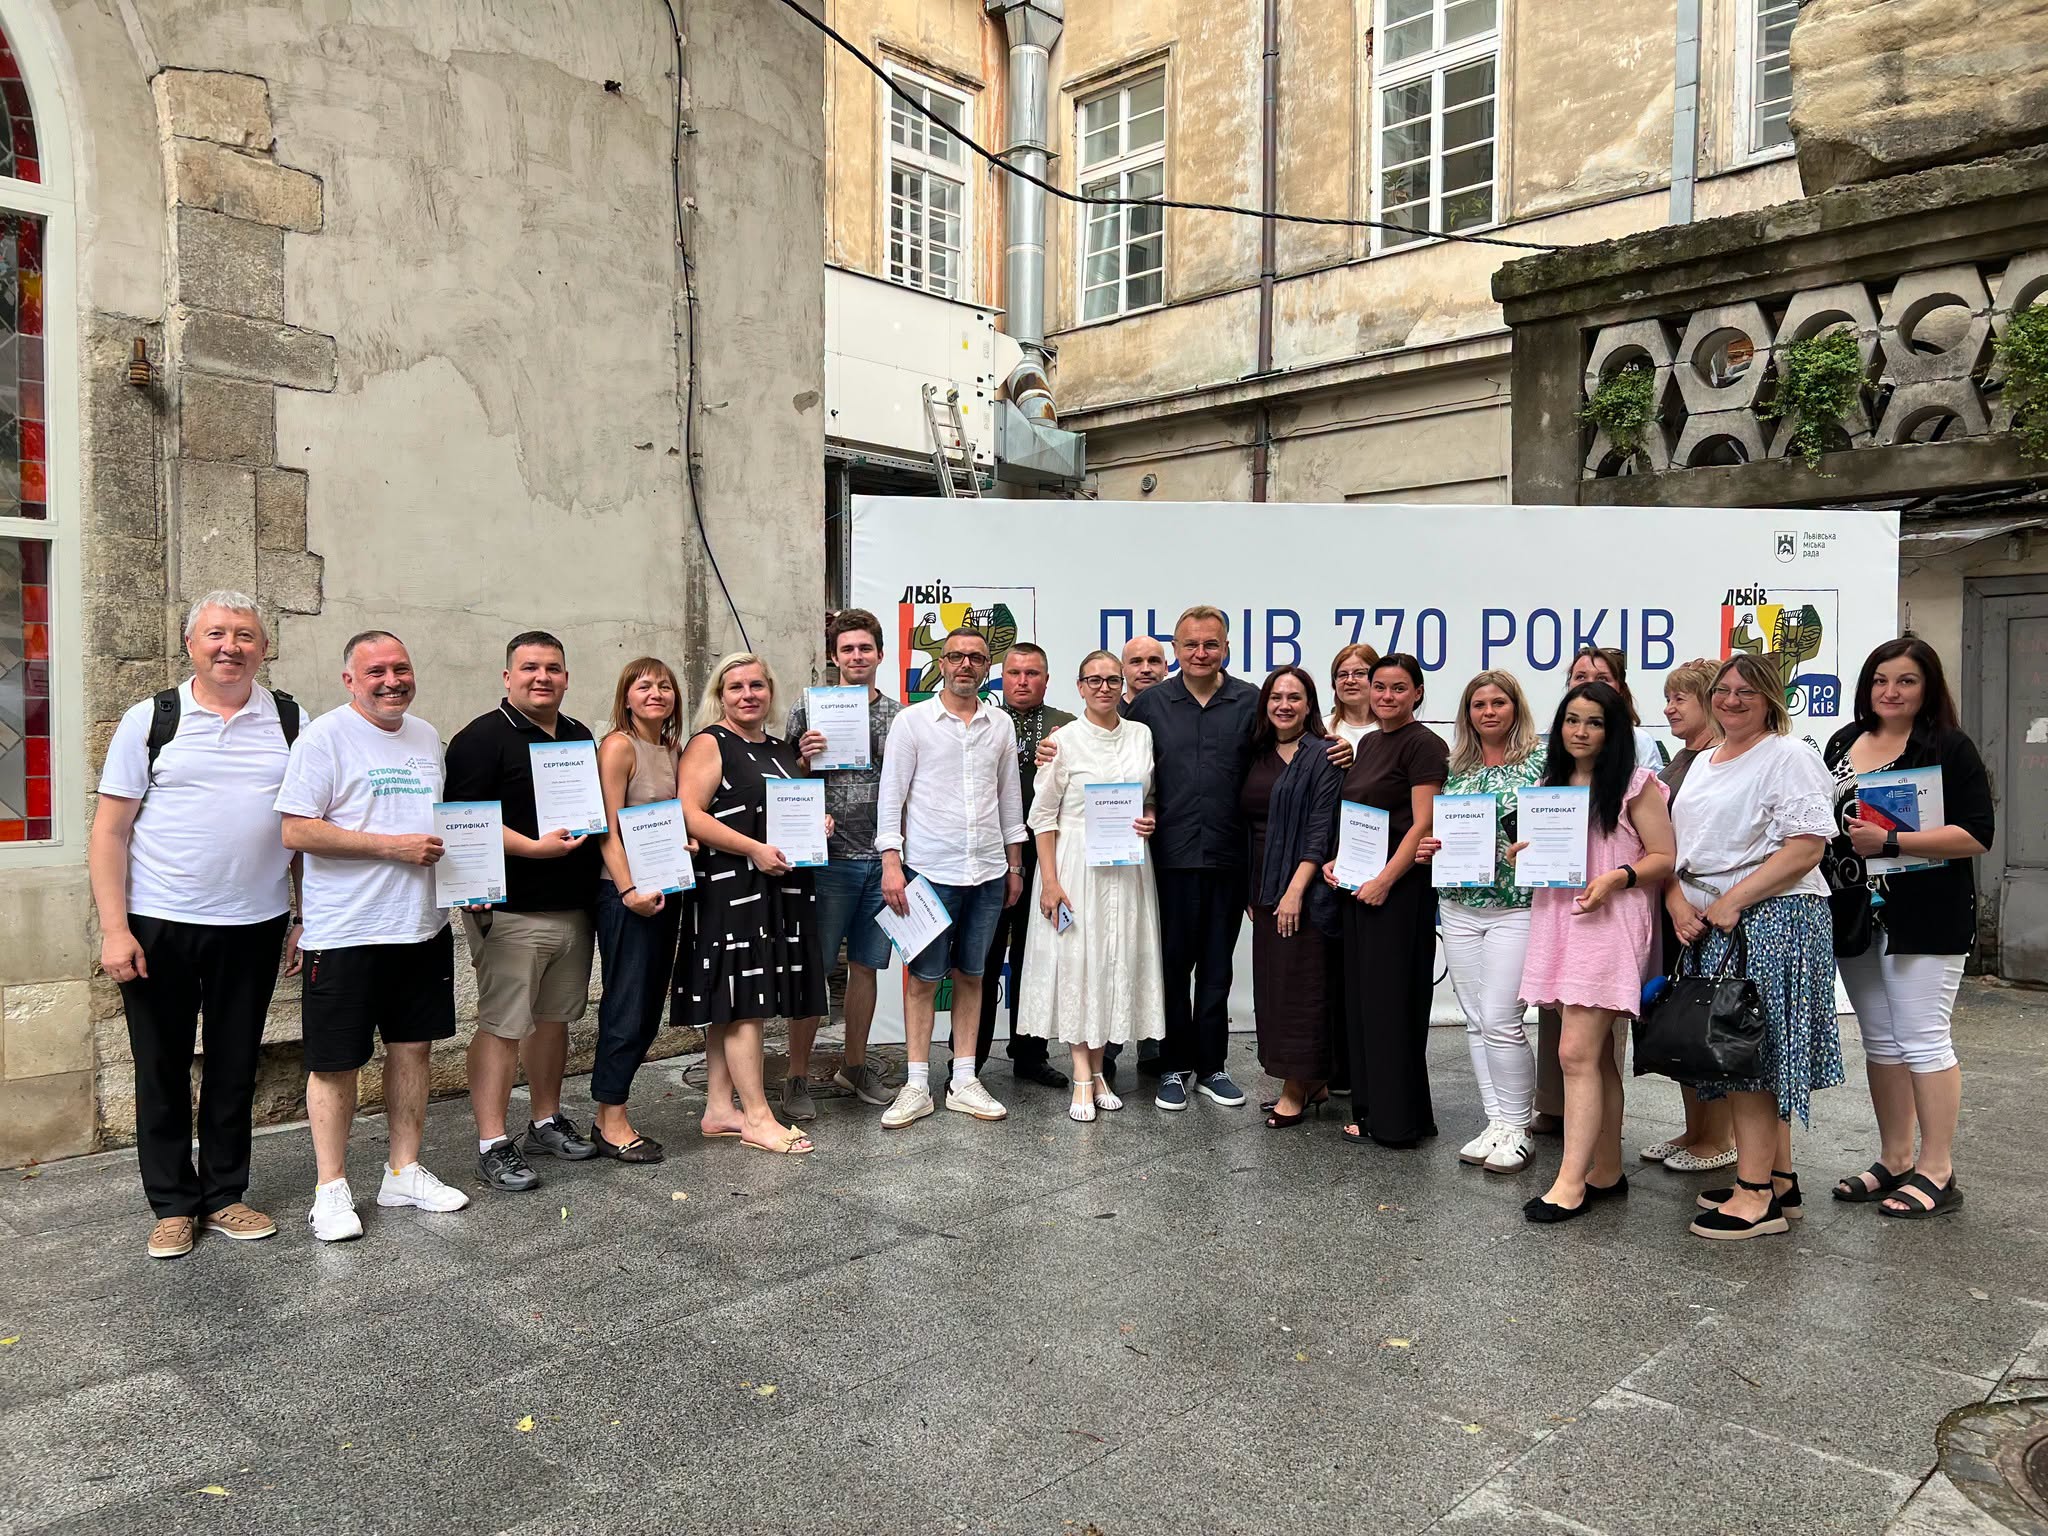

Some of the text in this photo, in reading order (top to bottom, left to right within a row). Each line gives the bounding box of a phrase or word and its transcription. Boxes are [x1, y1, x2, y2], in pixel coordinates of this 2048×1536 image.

[1803, 531, 1837, 540] Львівська
[1802, 550, 1820, 558] рада
[1335, 608, 1448, 672] 770
[1481, 608, 1675, 671] РОКІВ
[1812, 685, 1835, 699] РО
[543, 760, 585, 769] СЕРТИФІКАТ
[445, 822, 490, 830] СЕРТИФІКАТ
[632, 819, 672, 832] СЕРТИФІКАТ
[1349, 819, 1381, 832] СЕРТИФІКАТ
